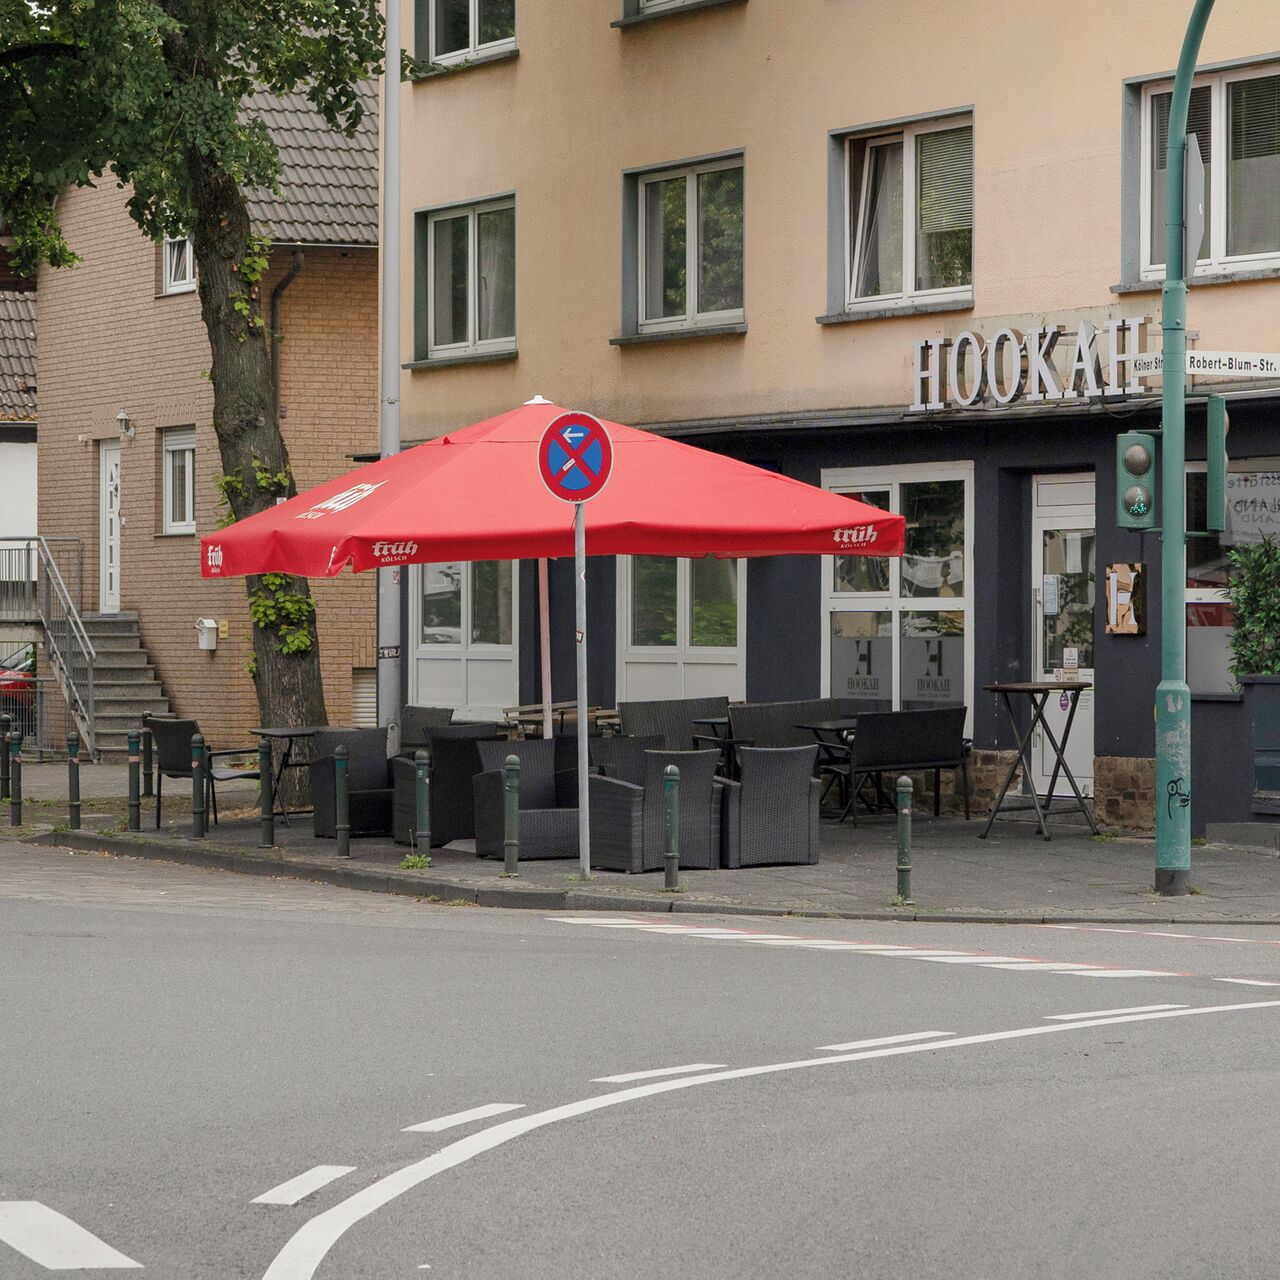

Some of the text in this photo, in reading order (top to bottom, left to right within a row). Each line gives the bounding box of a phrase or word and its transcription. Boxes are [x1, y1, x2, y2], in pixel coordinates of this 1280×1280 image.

[909, 317, 1145, 412] HOOKAH
[1133, 358, 1153, 372] Kölner
[1189, 355, 1278, 372] Robert-Blum-Str.
[372, 540, 418, 557] früh
[847, 677, 880, 691] HOOKAH
[916, 678, 951, 692] HOOKAH
